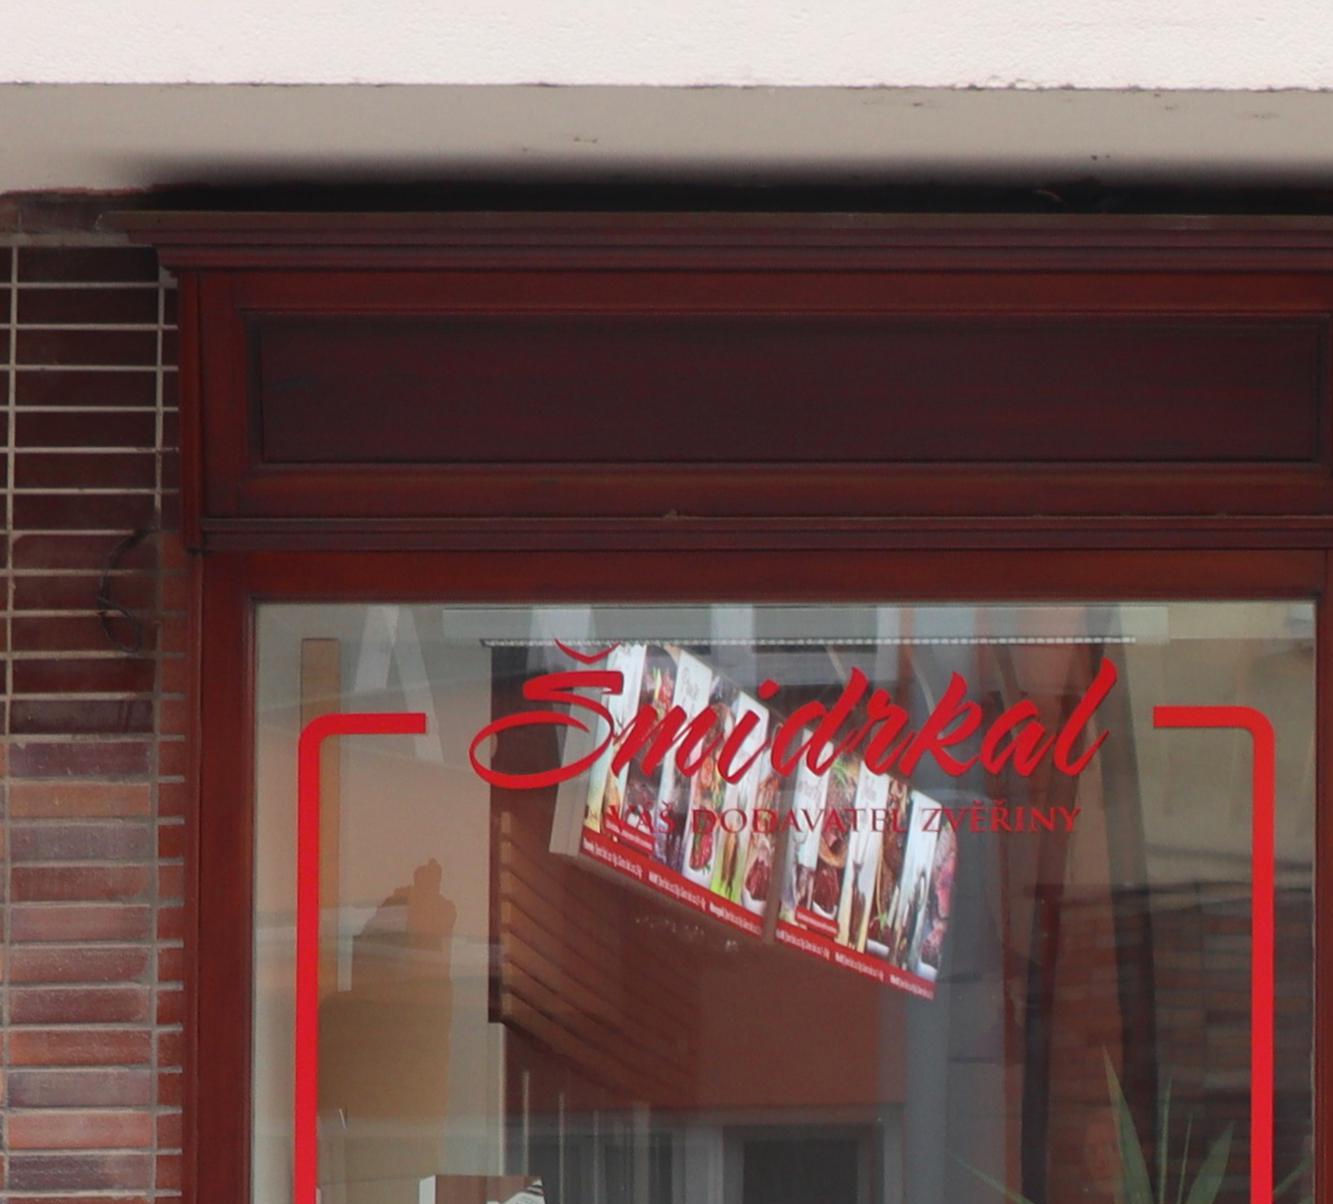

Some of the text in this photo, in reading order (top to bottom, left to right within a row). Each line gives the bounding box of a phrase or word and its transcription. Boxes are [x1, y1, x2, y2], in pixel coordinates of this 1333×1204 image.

[468, 638, 1119, 789] Šmidrkal
[692, 806, 907, 833] DODAVATEL
[922, 799, 1082, 833] ZVĚŘINY
